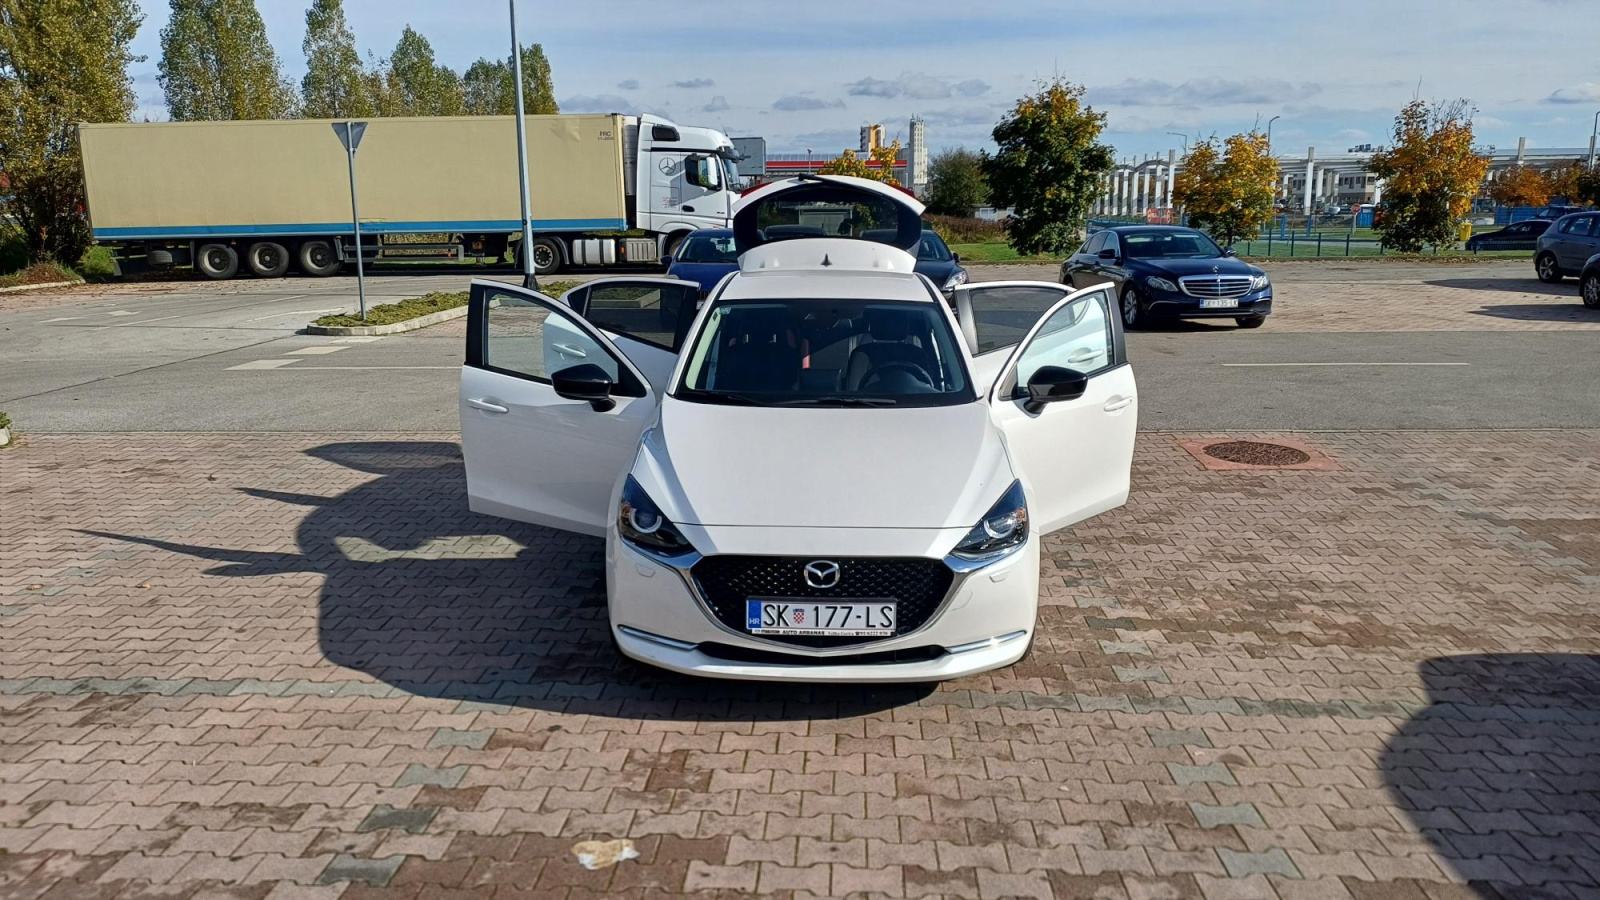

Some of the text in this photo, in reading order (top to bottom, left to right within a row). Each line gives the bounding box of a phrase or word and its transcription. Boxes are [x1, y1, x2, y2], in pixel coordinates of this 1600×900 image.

[749, 617, 760, 625] HR
[763, 604, 893, 628] SK 177-LS
